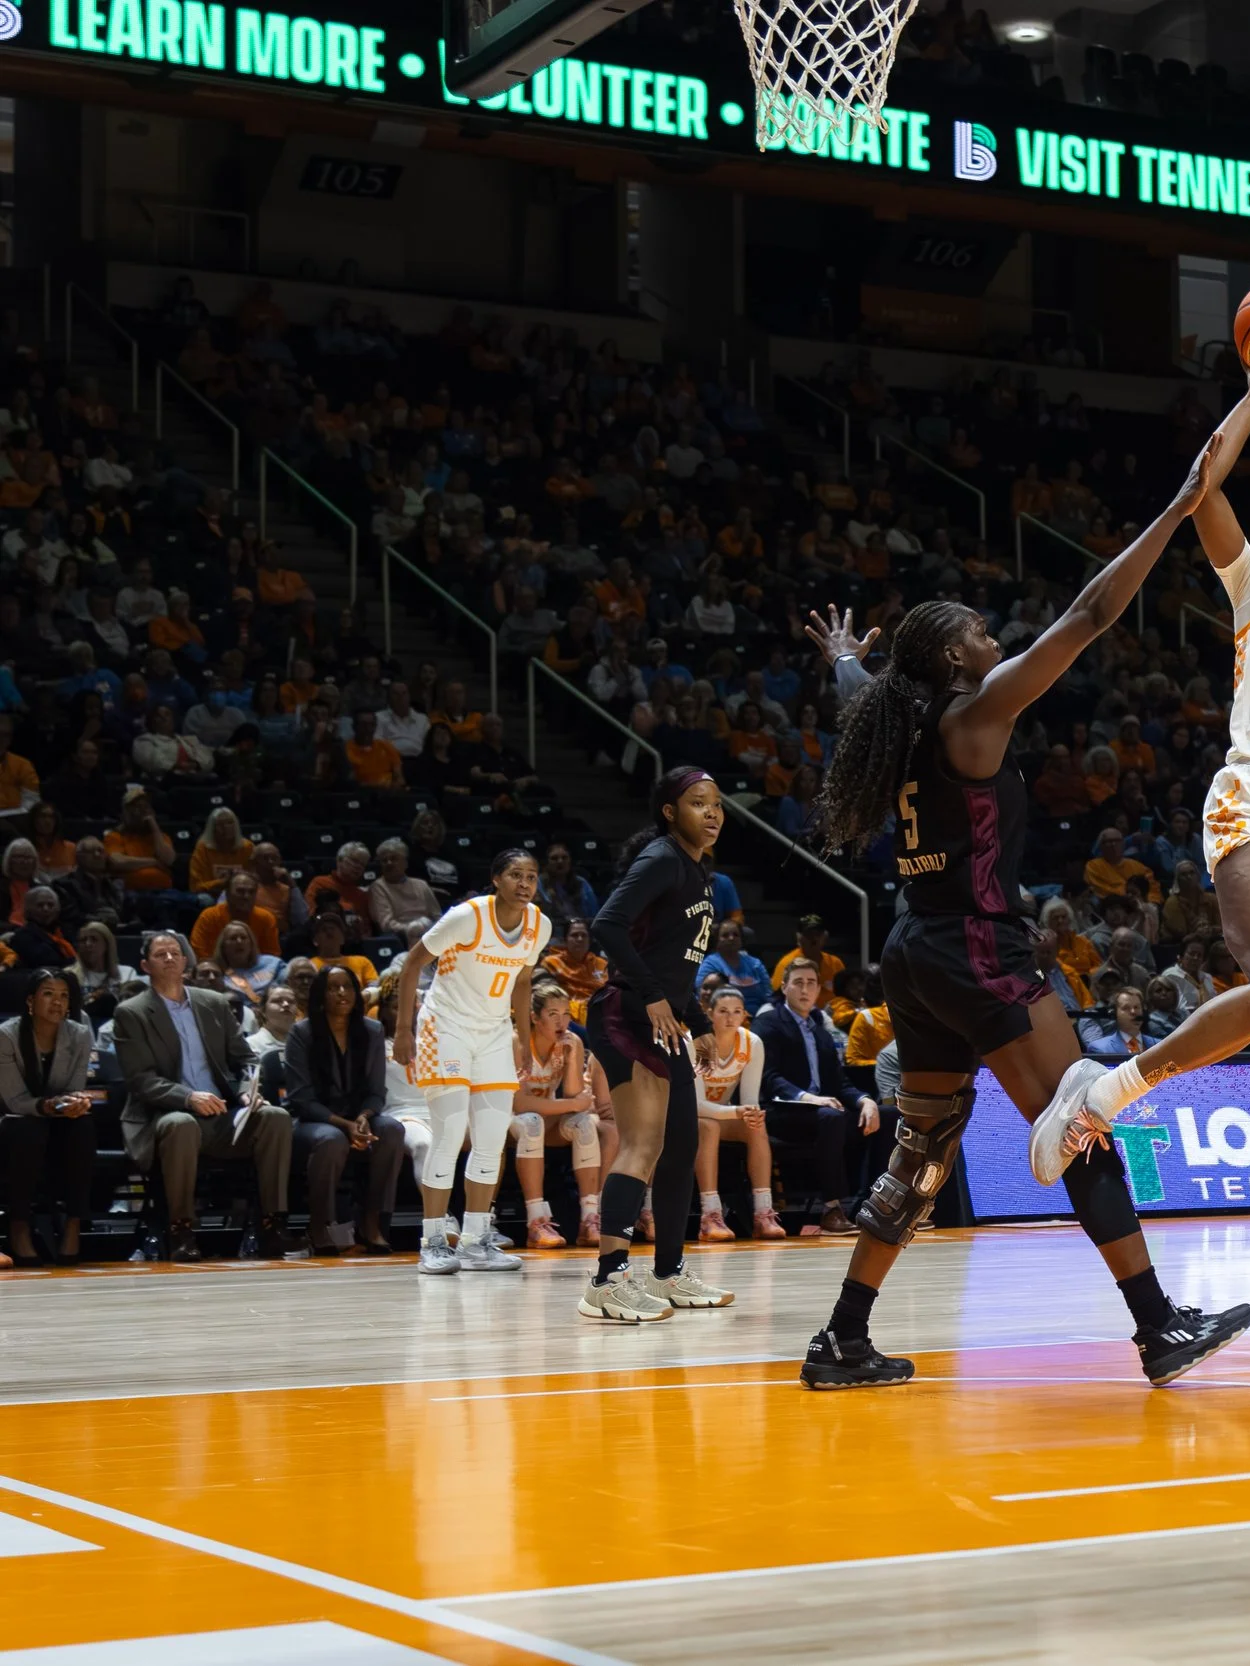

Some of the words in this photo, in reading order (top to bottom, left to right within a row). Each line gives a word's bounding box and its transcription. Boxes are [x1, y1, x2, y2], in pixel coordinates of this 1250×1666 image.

[50, 0, 226, 70] LEARN
[236, 8, 386, 93] MORE
[438, 38, 709, 140] LUNTEER
[756, 88, 931, 172] DONATE
[315, 163, 385, 196] 105
[1015, 127, 1126, 197] VISIT
[913, 235, 976, 268] 106
[898, 781, 919, 850] 5
[489, 971, 511, 998] 0
